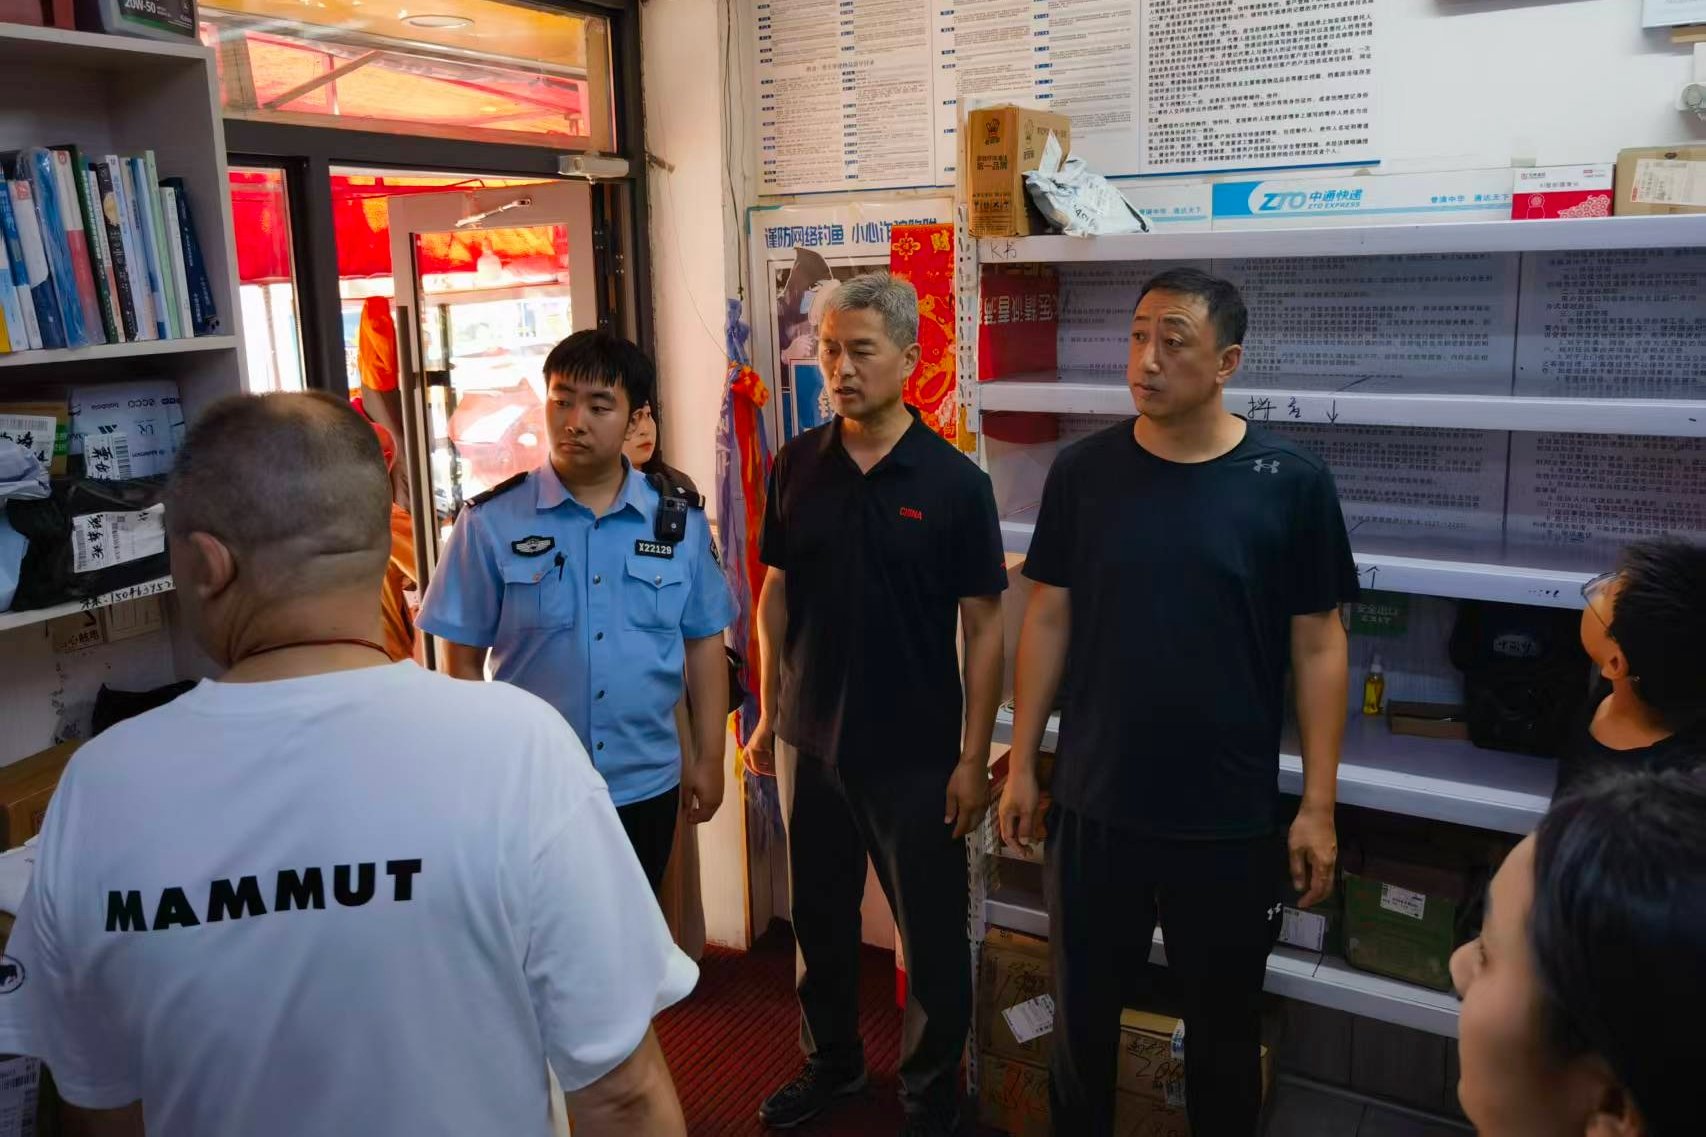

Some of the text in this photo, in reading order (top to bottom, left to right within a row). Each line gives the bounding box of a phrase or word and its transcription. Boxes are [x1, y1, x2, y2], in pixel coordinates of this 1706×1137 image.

[1258, 192, 1307, 211] ZTO
[1309, 189, 1363, 204] 中通快递
[765, 224, 845, 248] 谨防网络钓鱼
[900, 507, 923, 520] CHINA
[638, 543, 672, 554] X22129
[105, 859, 422, 932] MAMMUT
